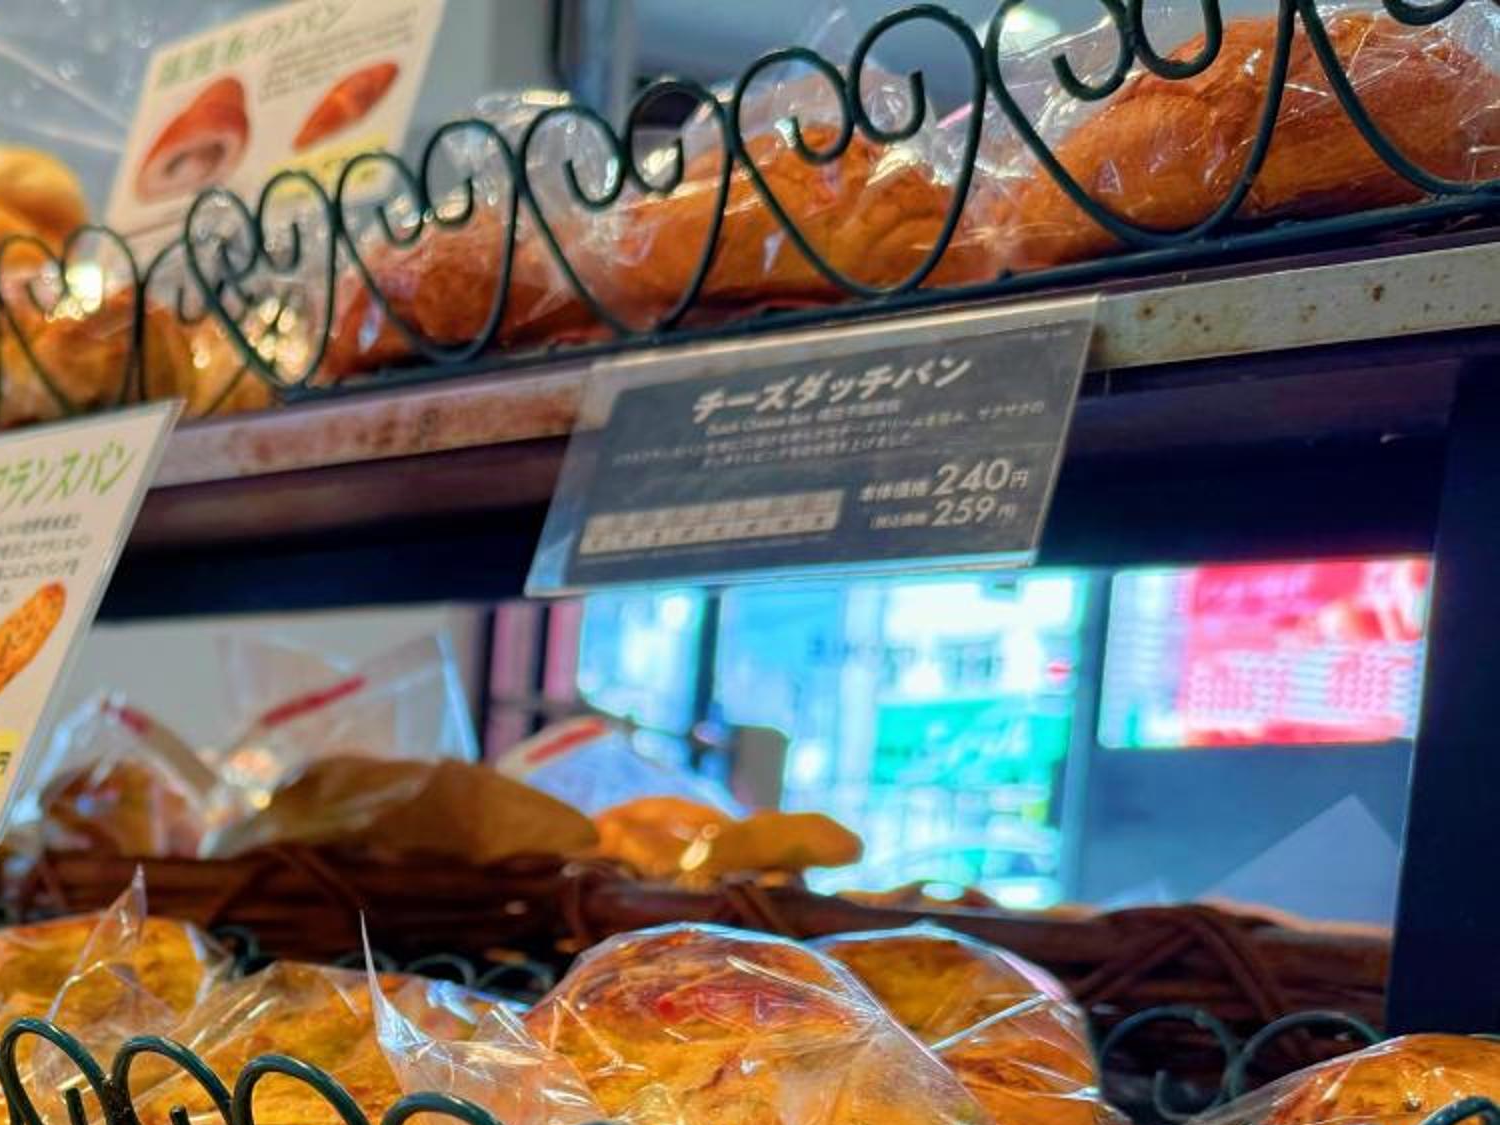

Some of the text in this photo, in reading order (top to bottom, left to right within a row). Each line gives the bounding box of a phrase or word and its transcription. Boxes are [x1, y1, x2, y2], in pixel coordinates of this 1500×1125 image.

[692, 358, 973, 424] チーズダッチパン
